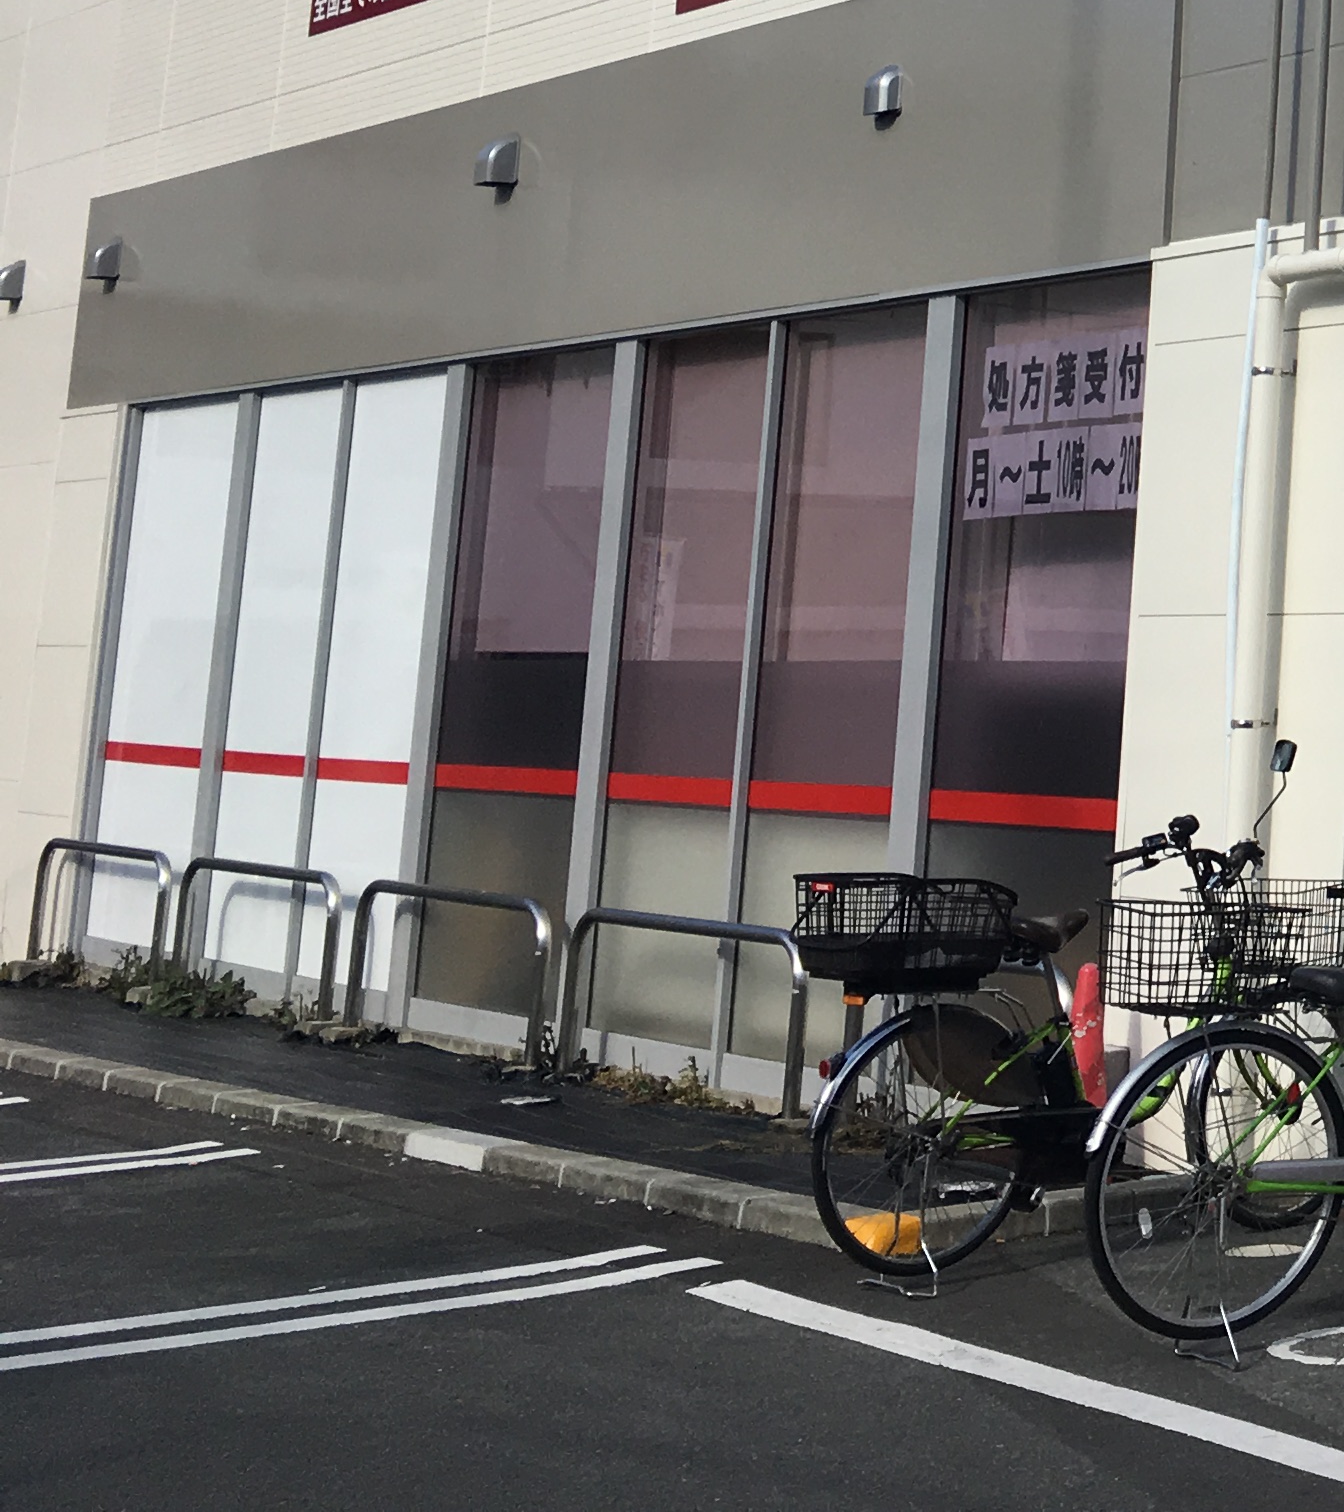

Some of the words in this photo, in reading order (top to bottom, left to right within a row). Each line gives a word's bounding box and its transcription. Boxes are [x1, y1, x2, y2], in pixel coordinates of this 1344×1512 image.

[988, 341, 1144, 413] 処方箋受付
